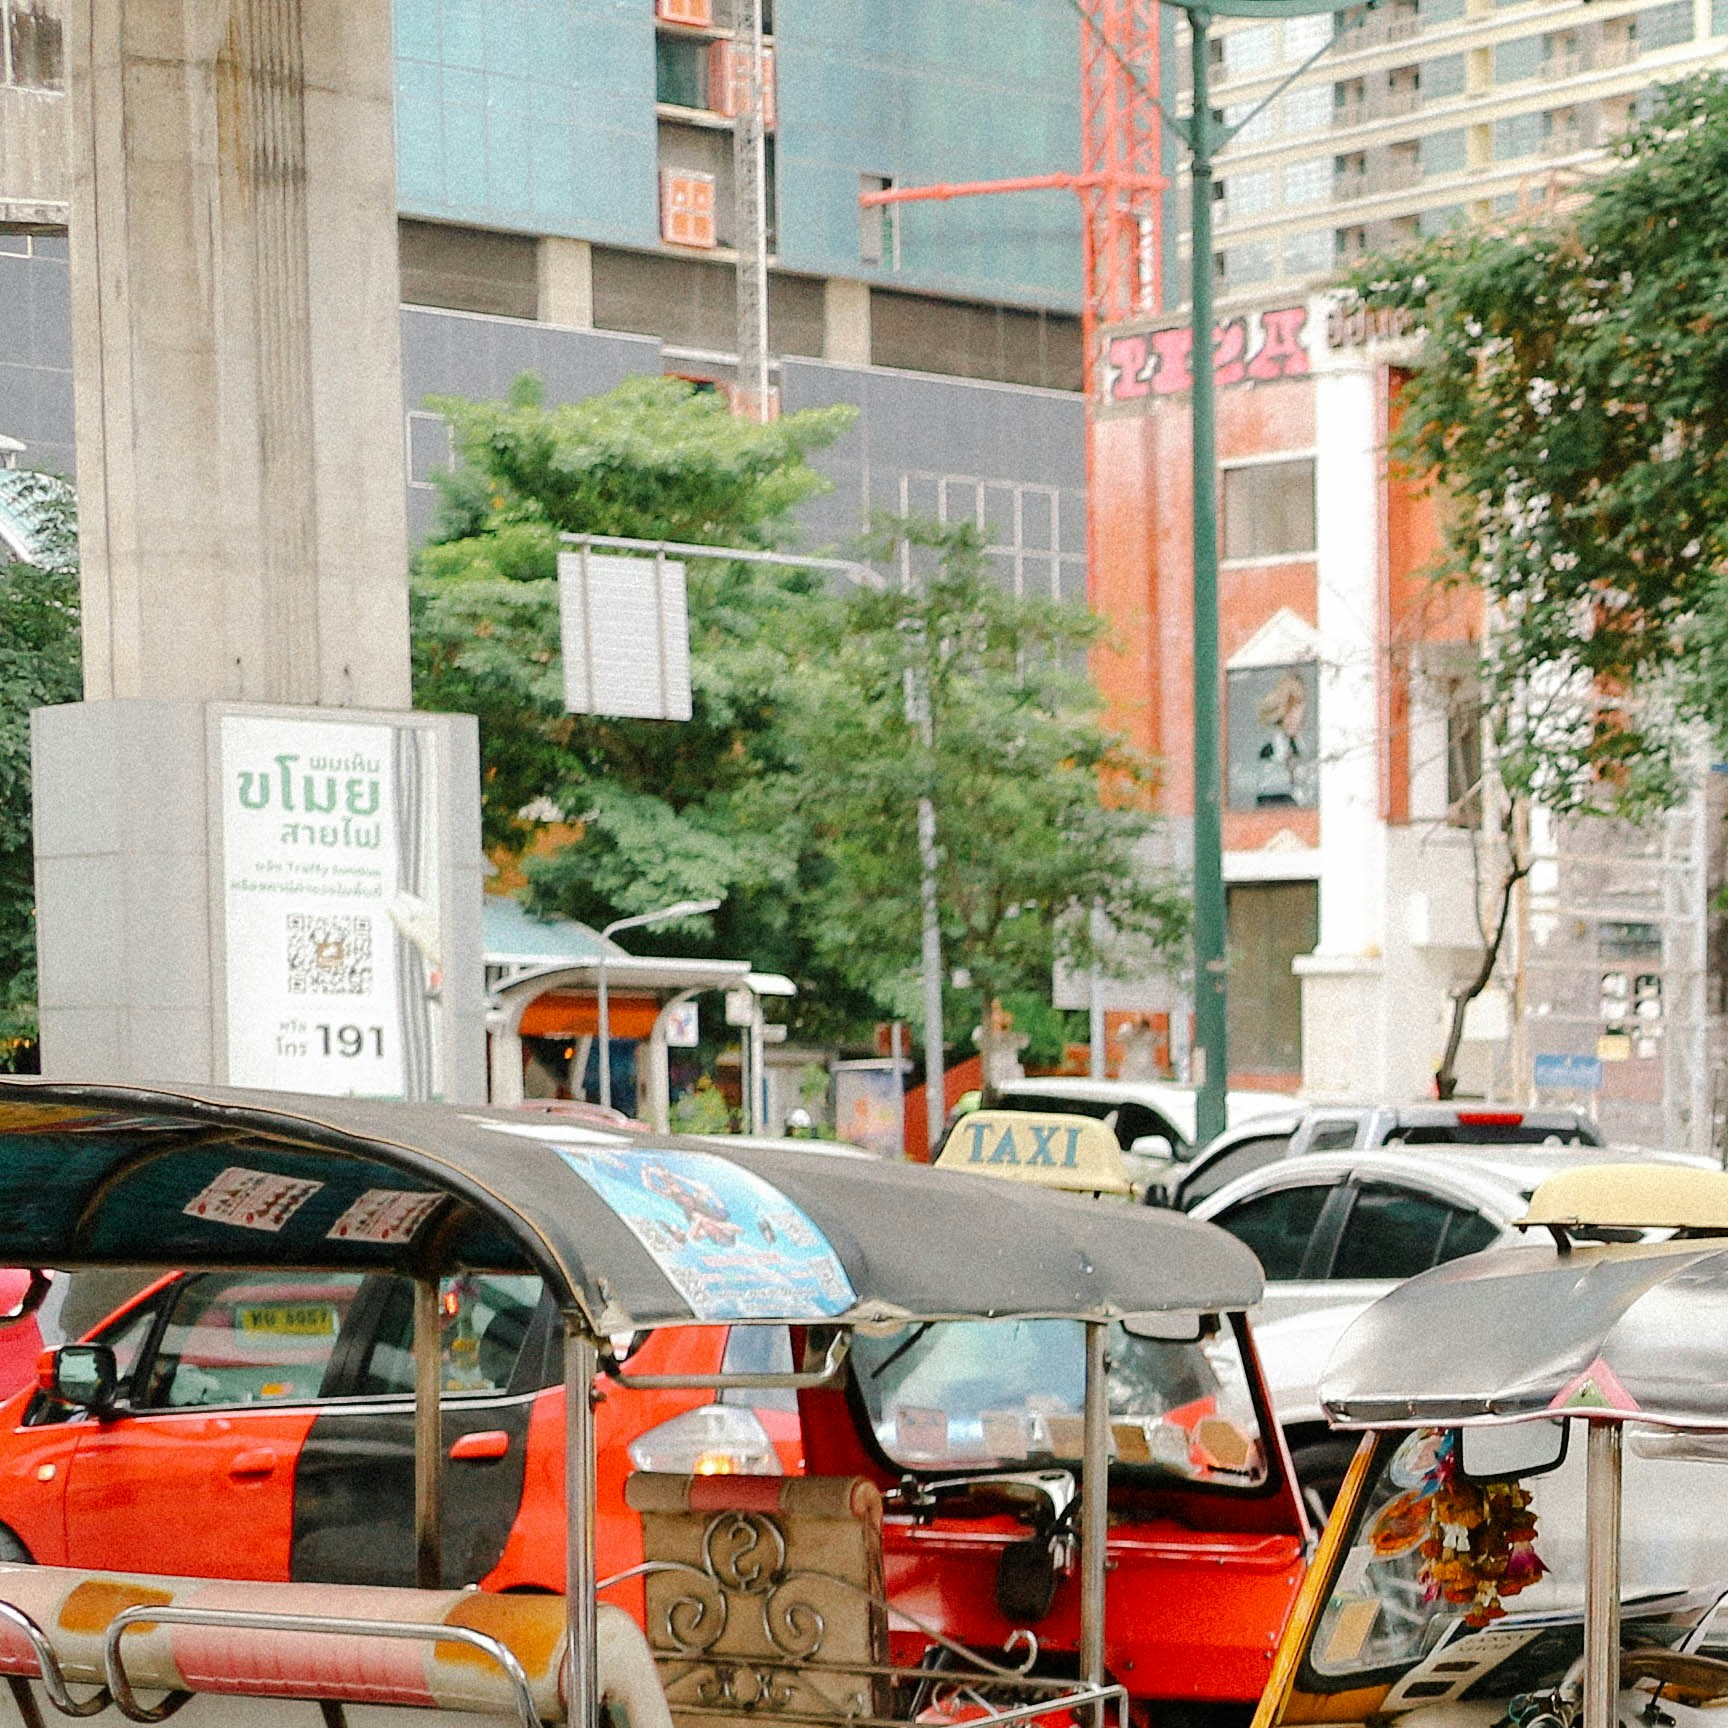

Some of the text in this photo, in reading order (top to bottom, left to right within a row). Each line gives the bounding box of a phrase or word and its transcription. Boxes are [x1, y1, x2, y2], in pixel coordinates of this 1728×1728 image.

[237, 754, 380, 816] ขโมย
[280, 816, 380, 849] สายไฟ
[316, 1022, 385, 1058] 191
[964, 1120, 1083, 1168] TAXI
